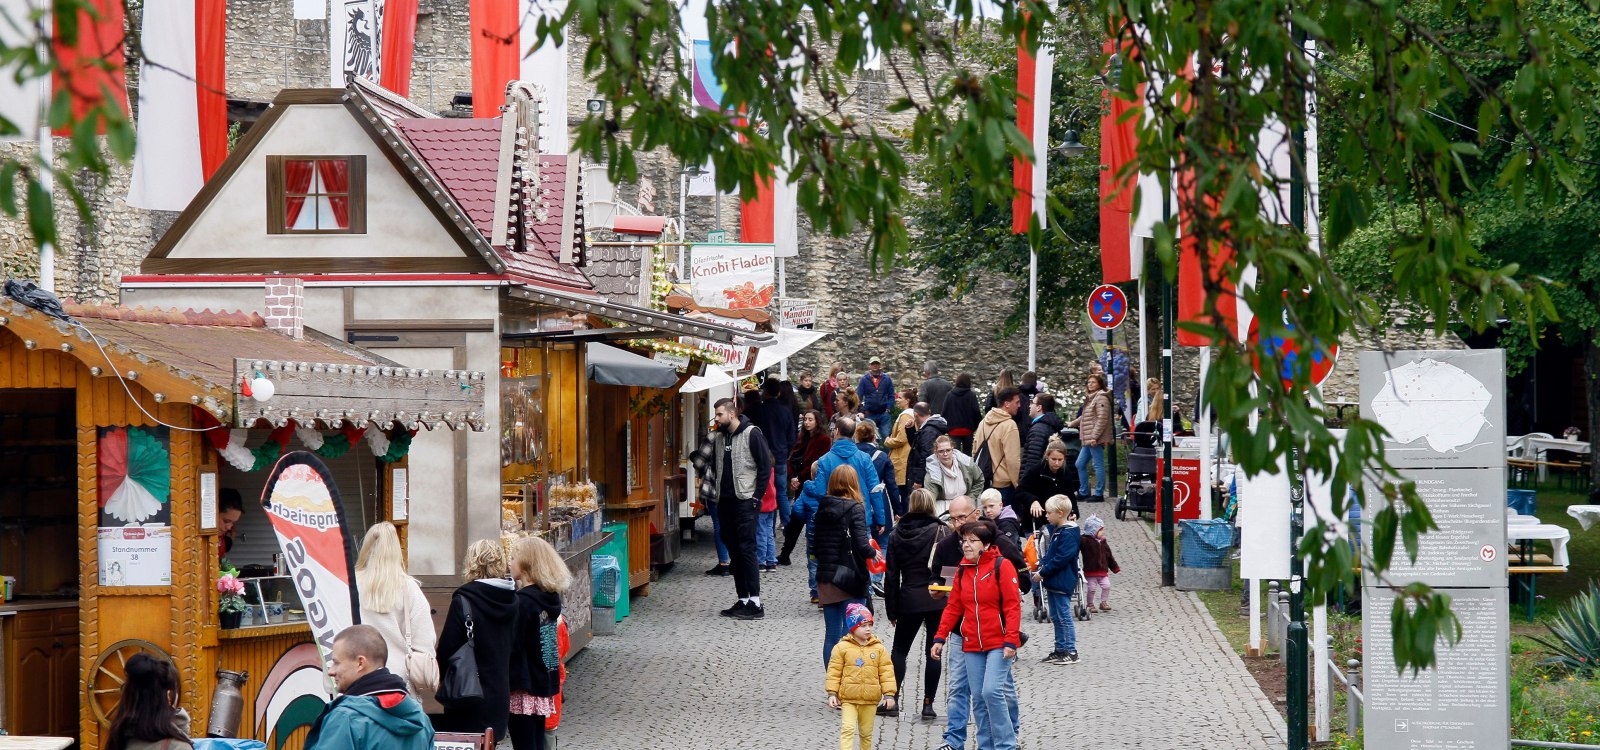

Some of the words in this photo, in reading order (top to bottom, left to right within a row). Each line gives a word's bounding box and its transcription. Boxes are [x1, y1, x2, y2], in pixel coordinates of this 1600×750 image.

[692, 262, 729, 278] Knobi
[731, 254, 773, 270] Fladen
[784, 310, 814, 320] Mandeln
